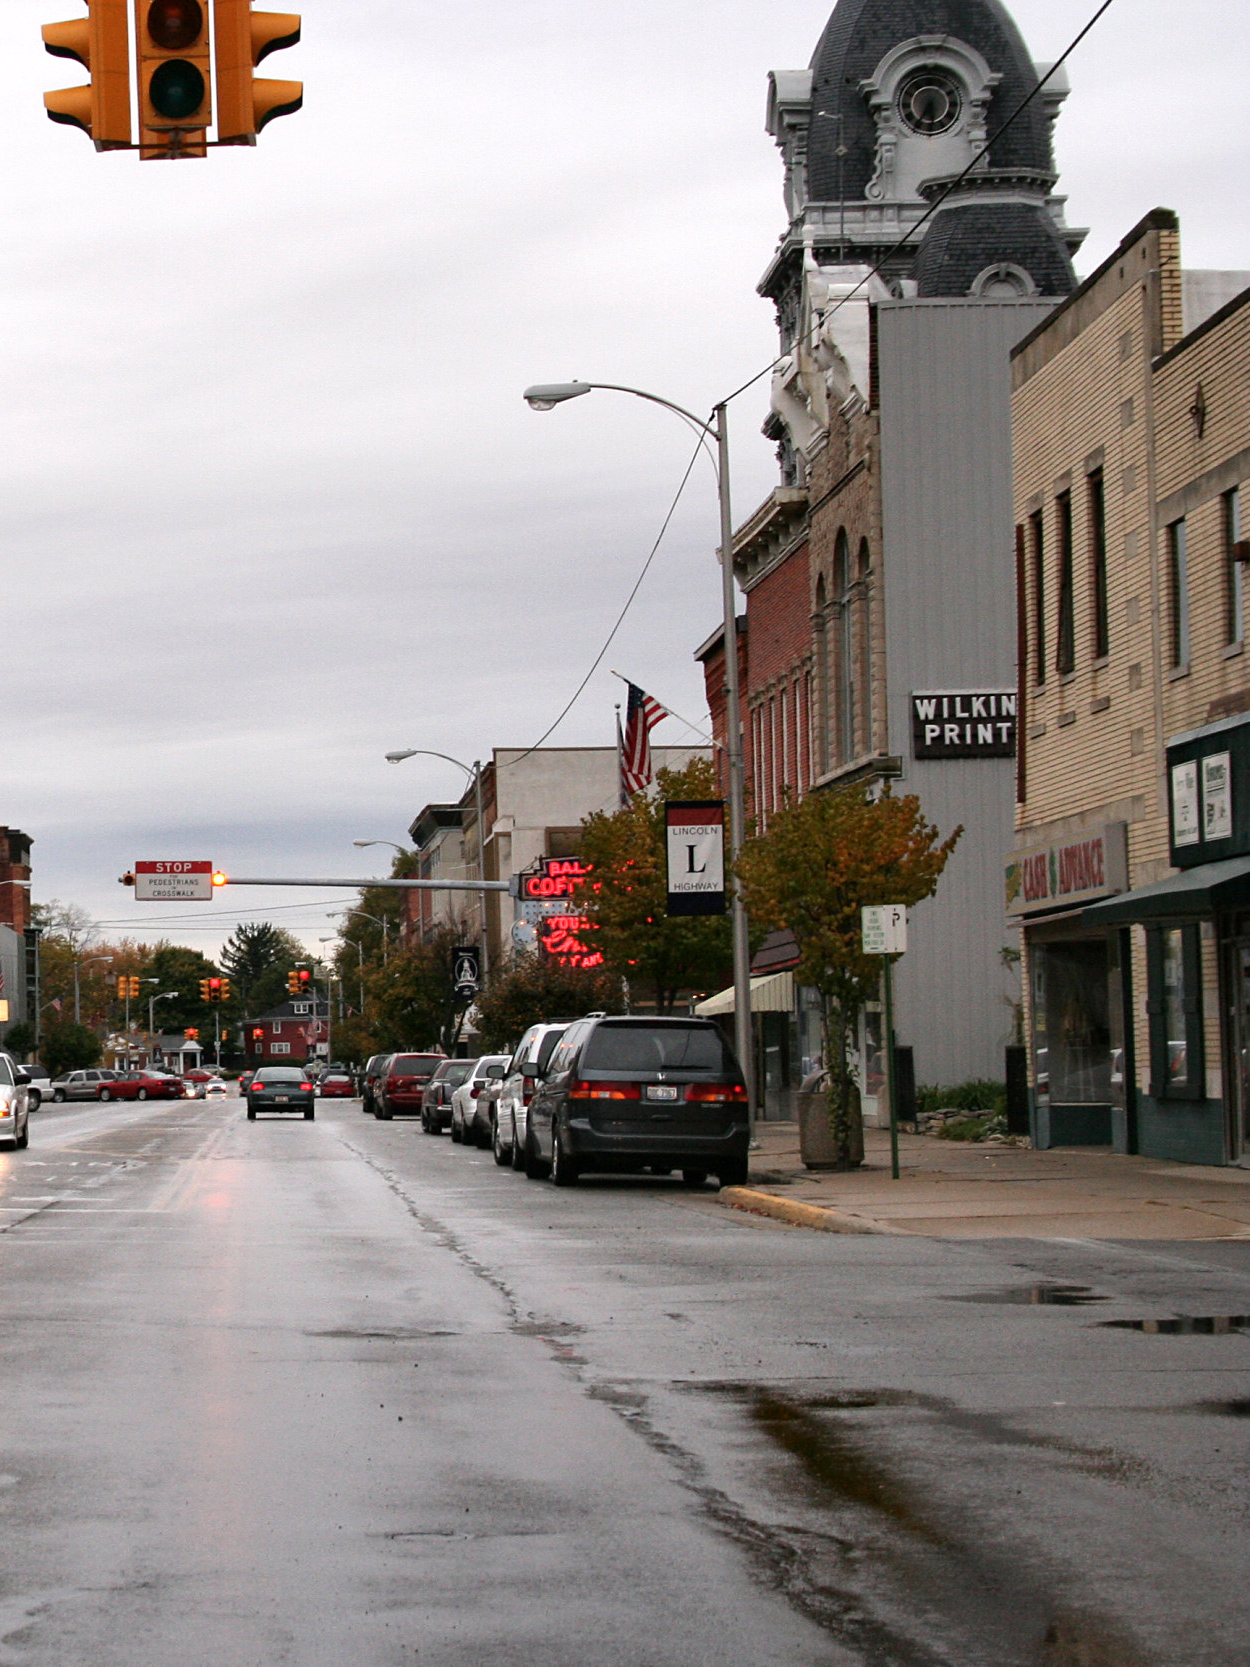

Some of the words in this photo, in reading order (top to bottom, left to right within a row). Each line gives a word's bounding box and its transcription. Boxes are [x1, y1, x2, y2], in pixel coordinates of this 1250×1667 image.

[914, 695, 1016, 720] WILKIN
[924, 722, 1012, 745] PRINT
[672, 827, 718, 836] LINCOLN
[155, 862, 192, 872] STOP
[686, 844, 707, 873] L
[549, 861, 593, 877] BAL
[1023, 853, 1048, 902] CASH
[1059, 838, 1104, 895] ADVANCE
[673, 882, 719, 891] HIGHWAY
